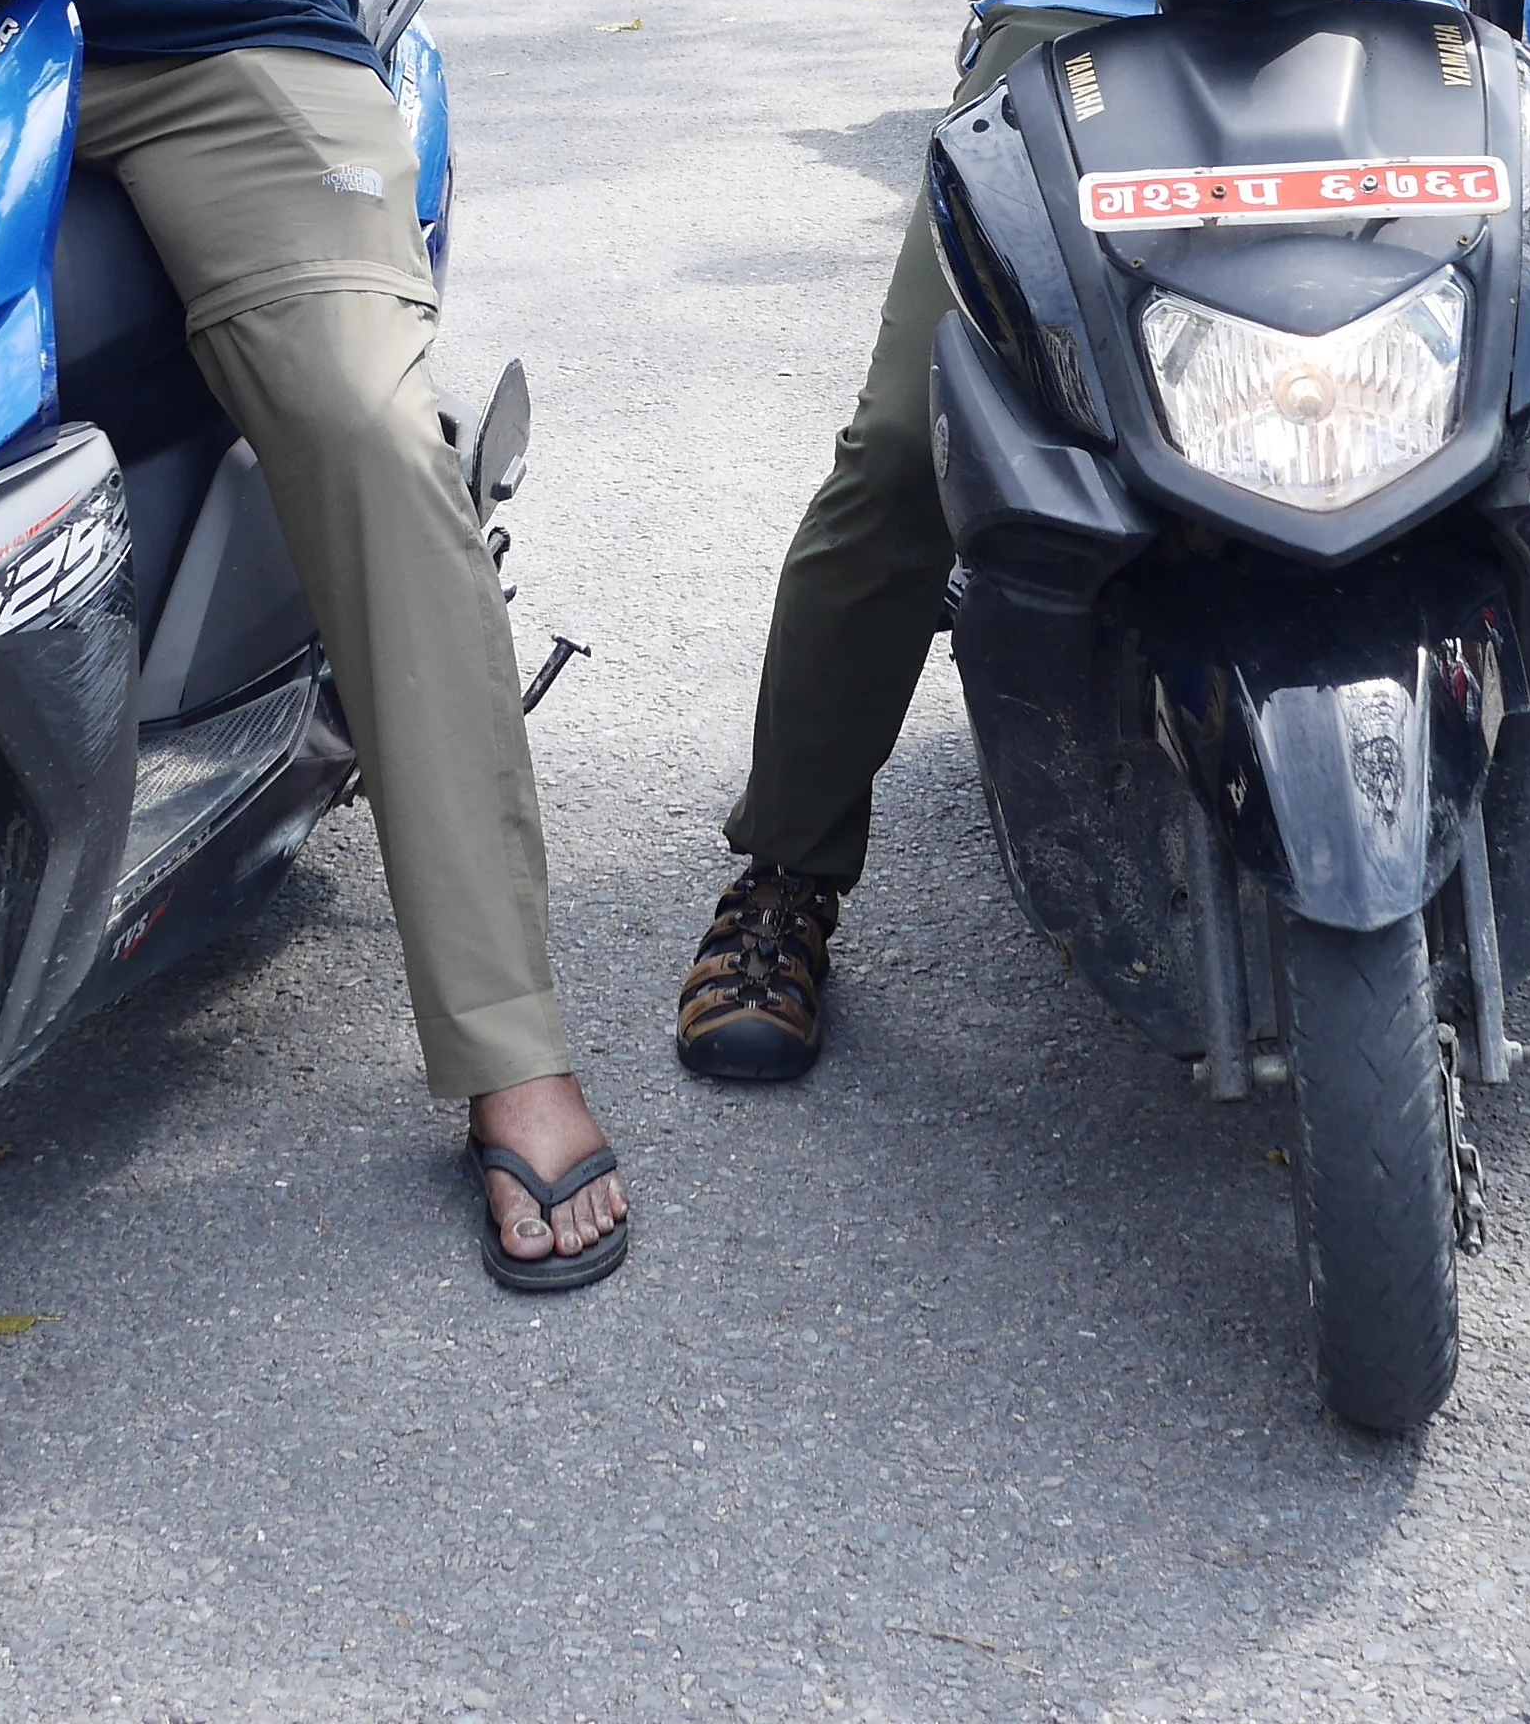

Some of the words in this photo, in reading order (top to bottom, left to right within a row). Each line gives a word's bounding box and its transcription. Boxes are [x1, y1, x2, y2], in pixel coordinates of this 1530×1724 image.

[1065, 52, 1106, 122] YAMAHA
[1434, 24, 1473, 87] YAMAHA
[111, 911, 150, 962] TVS
